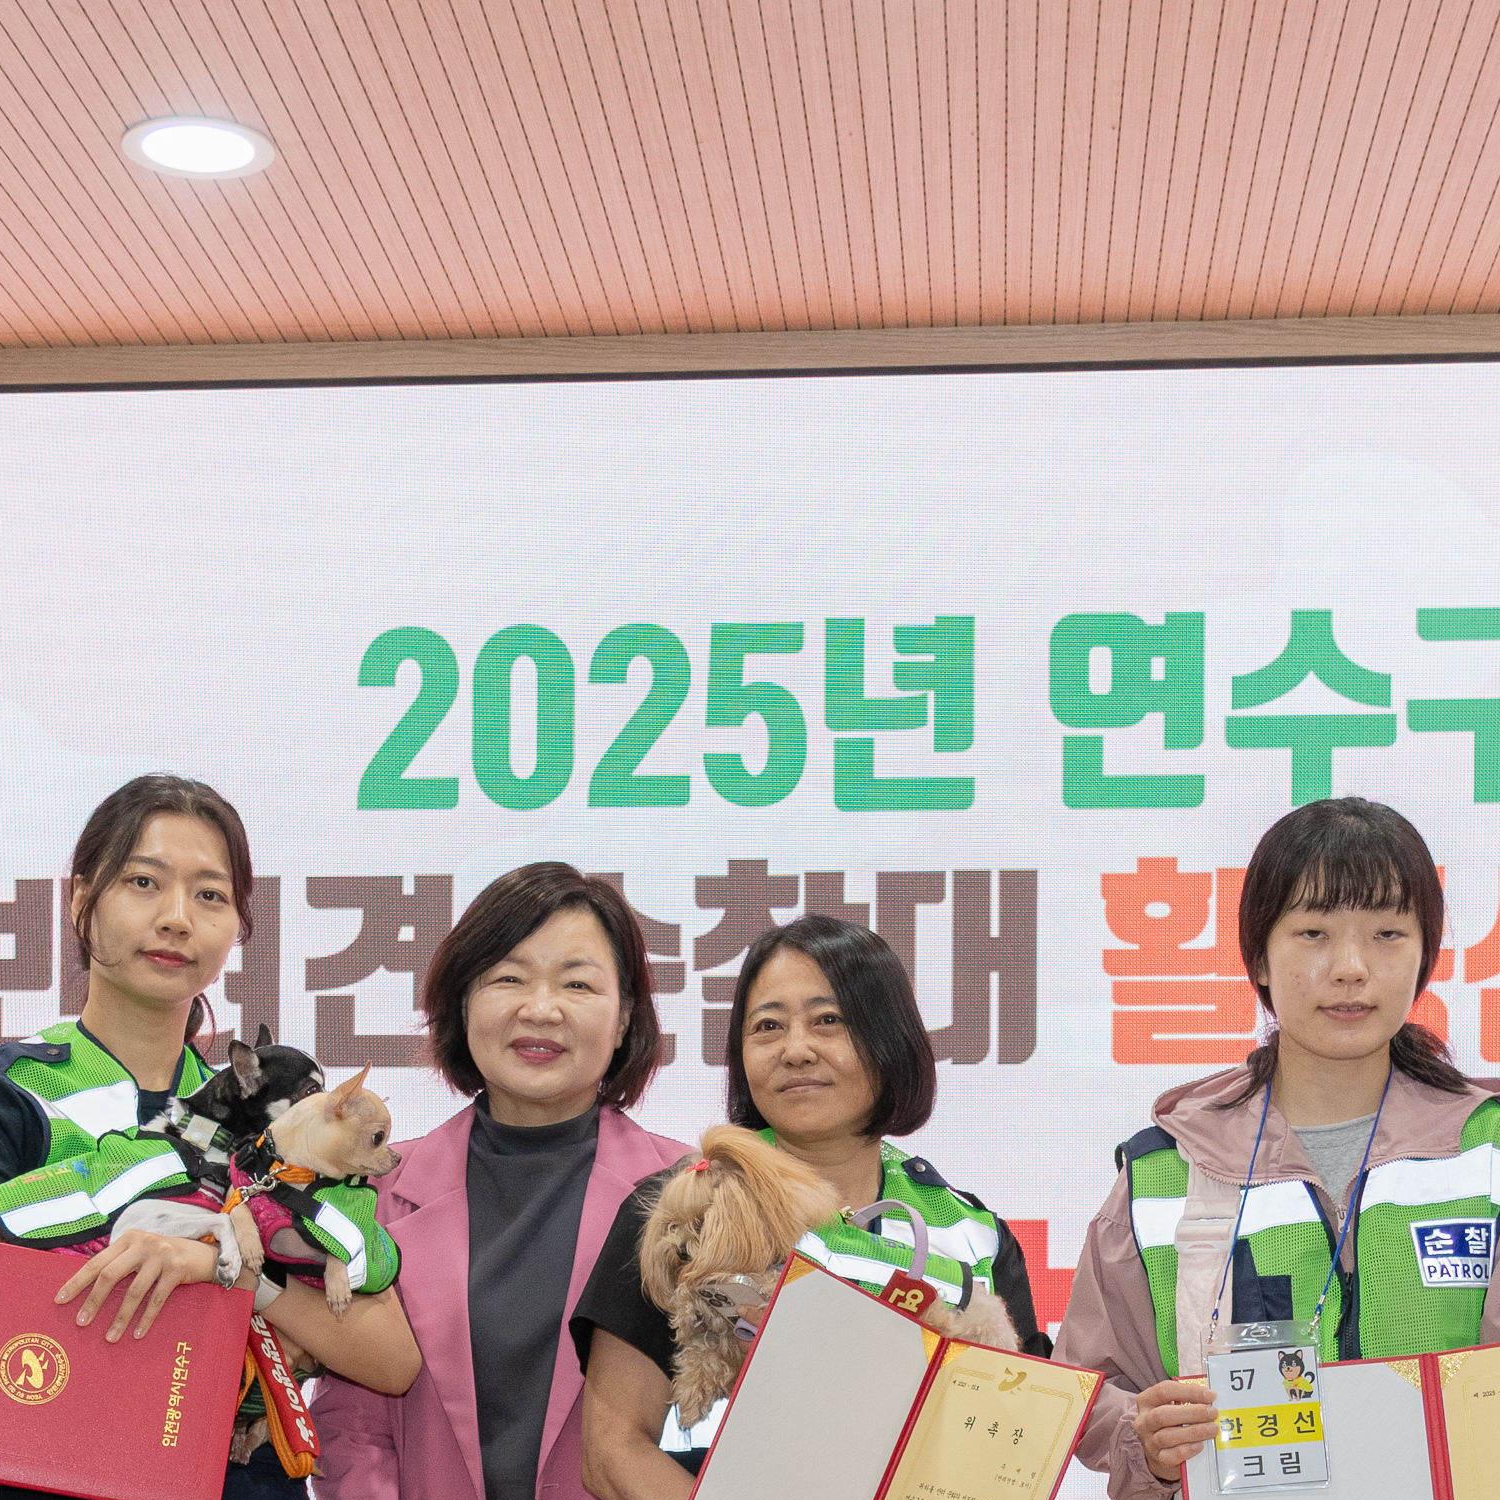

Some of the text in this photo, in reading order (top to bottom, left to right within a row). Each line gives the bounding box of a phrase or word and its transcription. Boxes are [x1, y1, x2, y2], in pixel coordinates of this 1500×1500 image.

[357, 615, 976, 812] 2025년
[1424, 1227, 1489, 1255] 순찰
[1427, 1264, 1489, 1279] PATROL
[1230, 1368, 1255, 1391] 57
[161, 1341, 192, 1447] 인천광역시연수구
